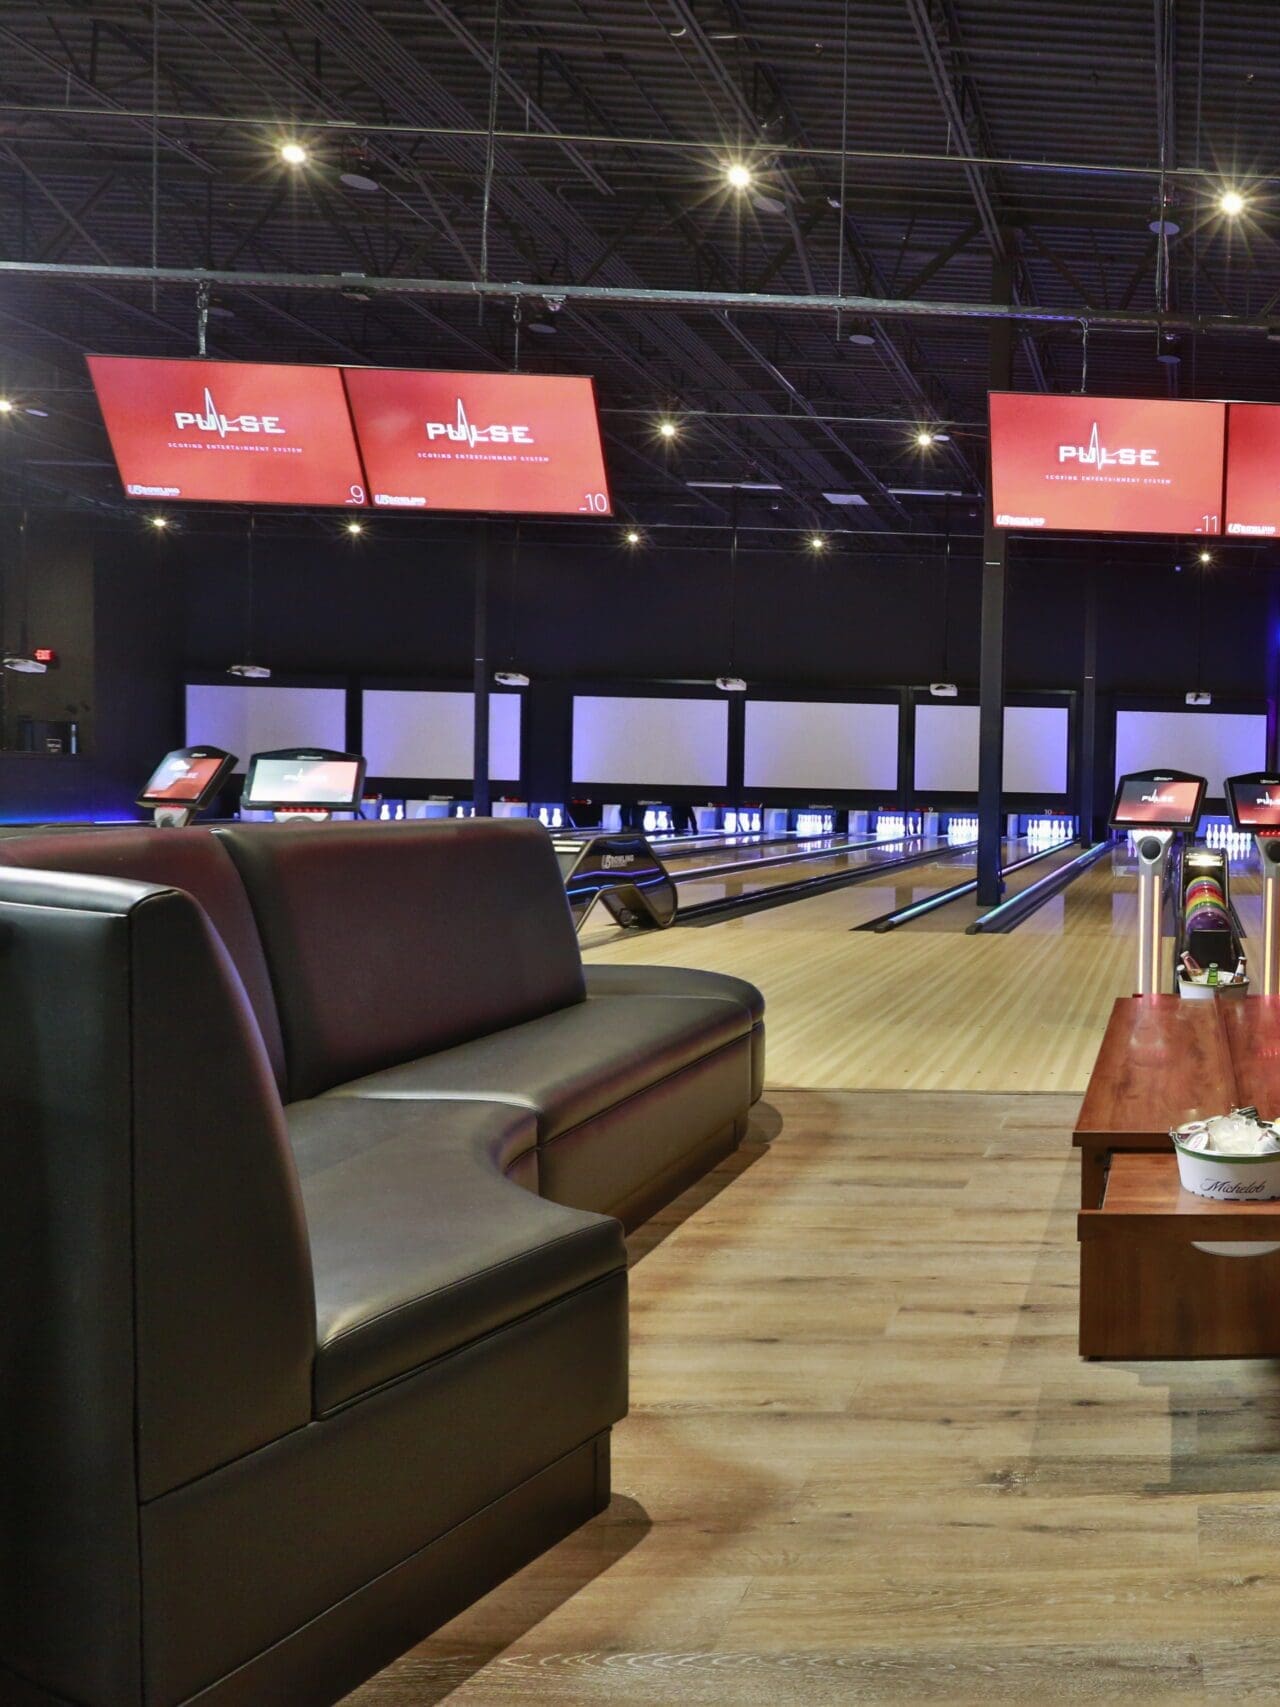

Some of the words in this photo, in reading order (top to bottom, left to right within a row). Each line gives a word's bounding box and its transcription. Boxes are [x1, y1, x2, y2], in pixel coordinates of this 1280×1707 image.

[174, 402, 286, 436] PULSE
[426, 413, 535, 445] PULSE
[206, 444, 269, 453] ENTERTAINMENT
[1058, 436, 1160, 468] PULSE
[455, 454, 517, 462] ENTERTAINMENT
[1081, 476, 1140, 484] ENTERTAINMENT
[1201, 1178, 1265, 1194] Michelob
